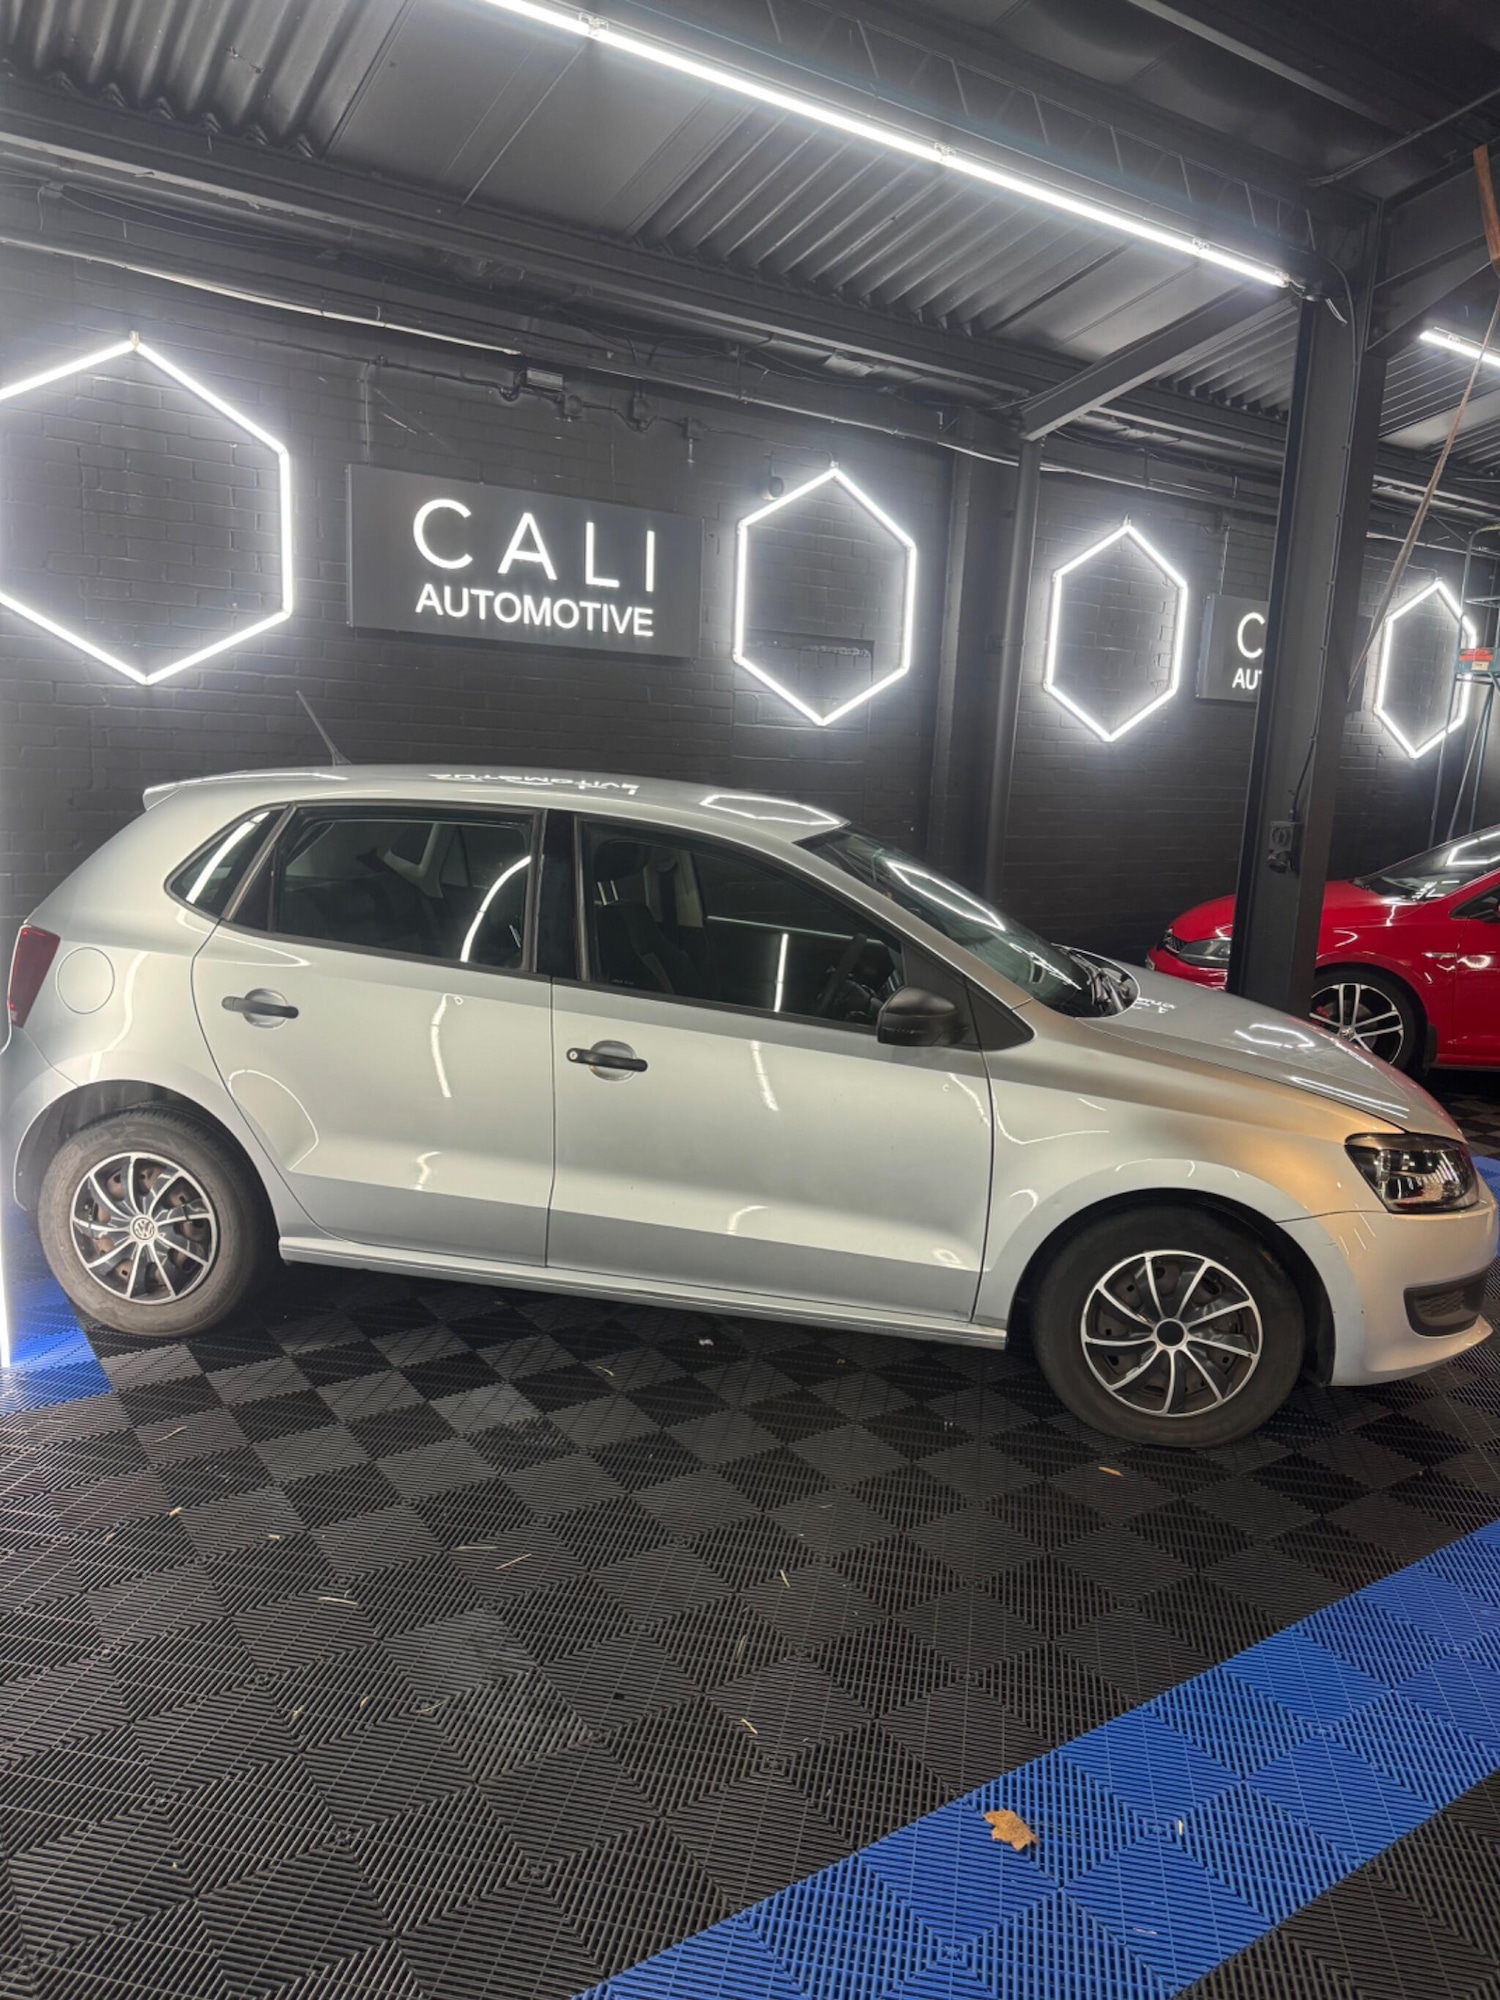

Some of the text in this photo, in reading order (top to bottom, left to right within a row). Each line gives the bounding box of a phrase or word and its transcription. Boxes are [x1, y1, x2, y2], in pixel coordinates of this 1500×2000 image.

[413, 499, 655, 592] CALI
[415, 583, 654, 636] AUTOMOTIVE
[1232, 667, 1262, 690] AU
